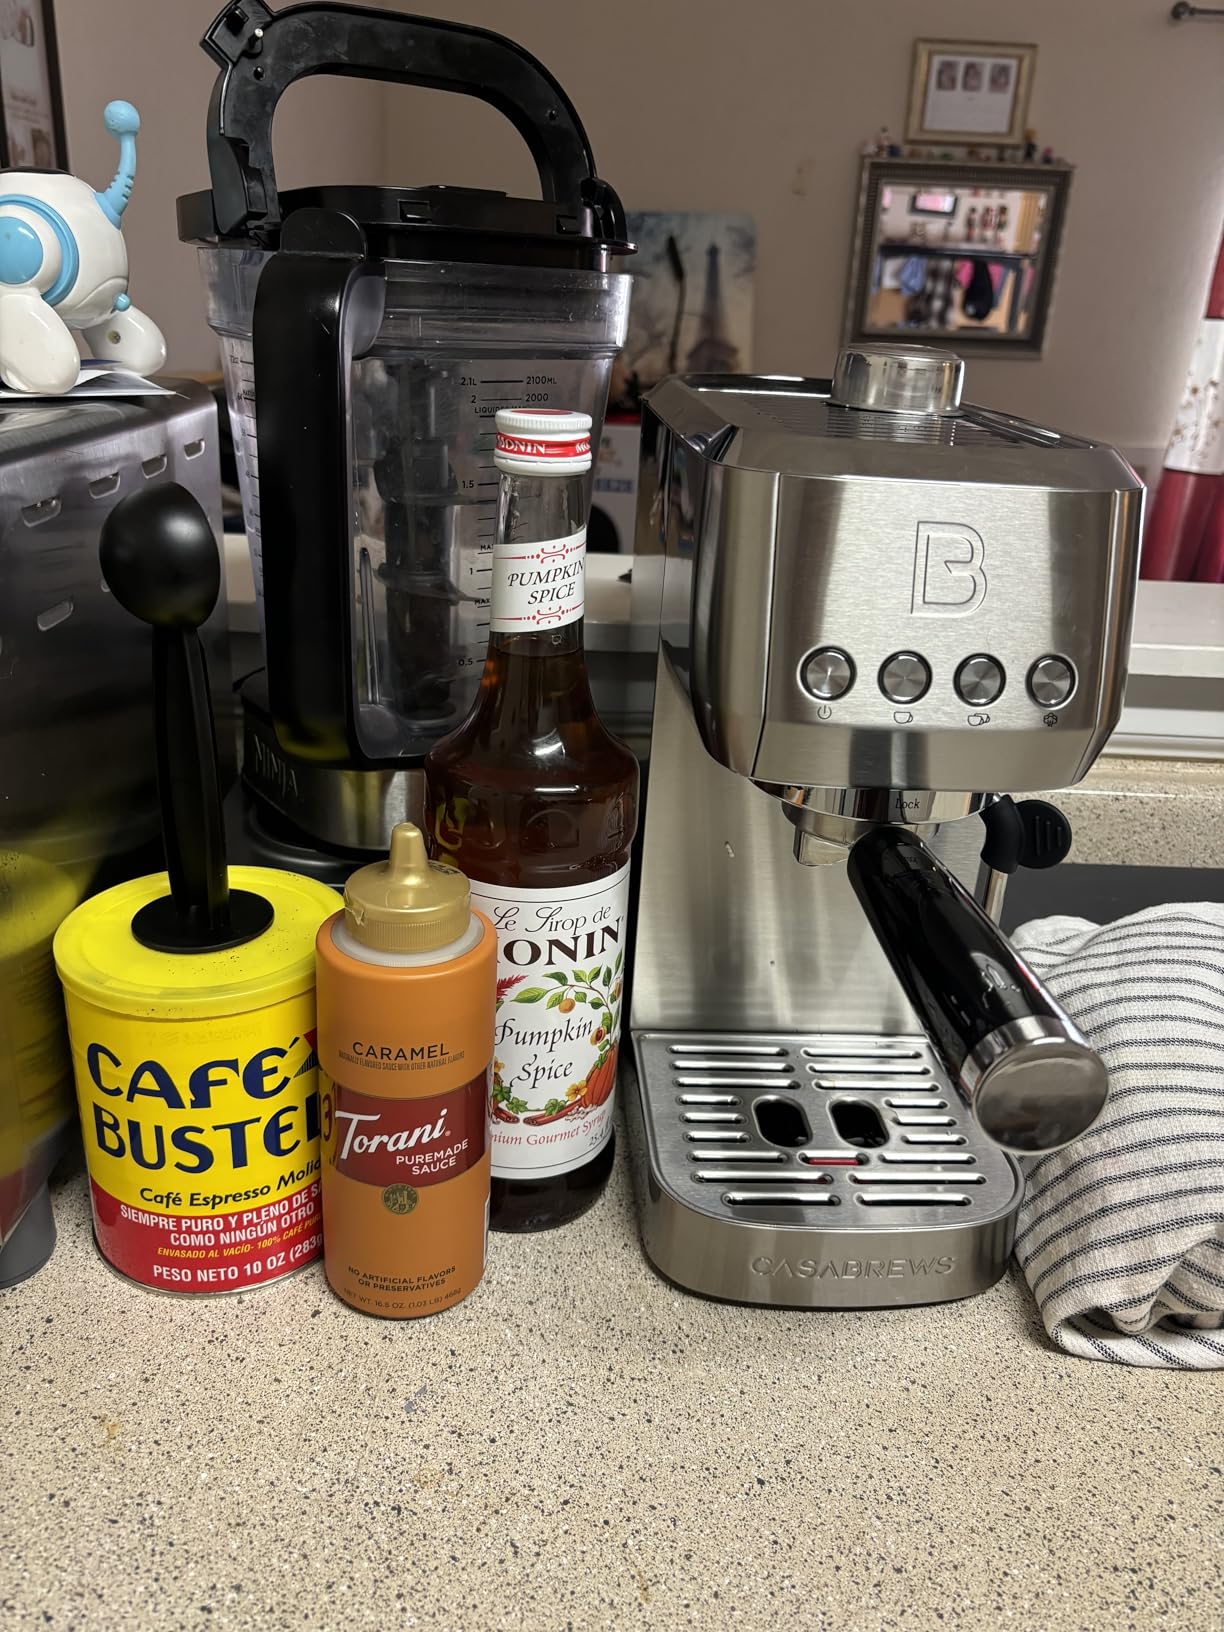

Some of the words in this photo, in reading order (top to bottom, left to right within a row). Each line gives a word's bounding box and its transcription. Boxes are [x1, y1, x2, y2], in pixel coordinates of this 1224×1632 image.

[460, 377, 477, 386] 2.1L
[526, 376, 557, 385] 2100ML
[471, 395, 477, 404] 2
[525, 393, 549, 402] 2000
[462, 480, 475, 489] 1.5
[507, 560, 585, 587] PUMPKIN
[527, 581, 576, 605] SPICE
[458, 657, 473, 667] 0.5
[895, 797, 920, 809] Lock
[493, 906, 520, 932] Le
[525, 906, 587, 936] Sirop
[592, 906, 611, 924] de
[497, 917, 621, 967] ONIN
[494, 1017, 594, 1054] Pumpkin
[352, 1041, 449, 1061] CARAMEL
[87, 1036, 301, 1110] CAFÉ
[509, 1054, 573, 1090] Spice
[335, 1108, 448, 1160] Torani
[526, 1125, 580, 1146] Gourmet
[396, 1138, 469, 1165] PUREMADE
[412, 1155, 457, 1175] SAUCE
[139, 1187, 182, 1209] Café
[189, 1184, 271, 1210] Espresso
[120, 1203, 177, 1231] SIEMPRE
[181, 1217, 224, 1232] PURO
[227, 1215, 239, 1229] Y
[242, 1199, 290, 1224] PLENO
[292, 1189, 309, 1209] DE
[170, 1232, 215, 1248] COMO
[219, 1219, 278, 1246] NINGÚN
[281, 1201, 315, 1229] OTRO
[157, 1246, 206, 1259] ENVASADO
[207, 1247, 220, 1259] AL
[257, 1234, 282, 1250] 100%
[153, 1264, 192, 1282] PESO
[197, 1265, 238, 1283] NETO
[243, 1262, 262, 1276] 10
[266, 1251, 286, 1270] OZ
[348, 1265, 360, 1276] NO
[362, 1272, 415, 1284] ARTIFICIAL
[416, 1265, 456, 1283] FLAVORS
[751, 1256, 955, 1279] CASABREWS
[358, 1278, 371, 1287] OR
[373, 1277, 446, 1292] PRESERVATIVES
